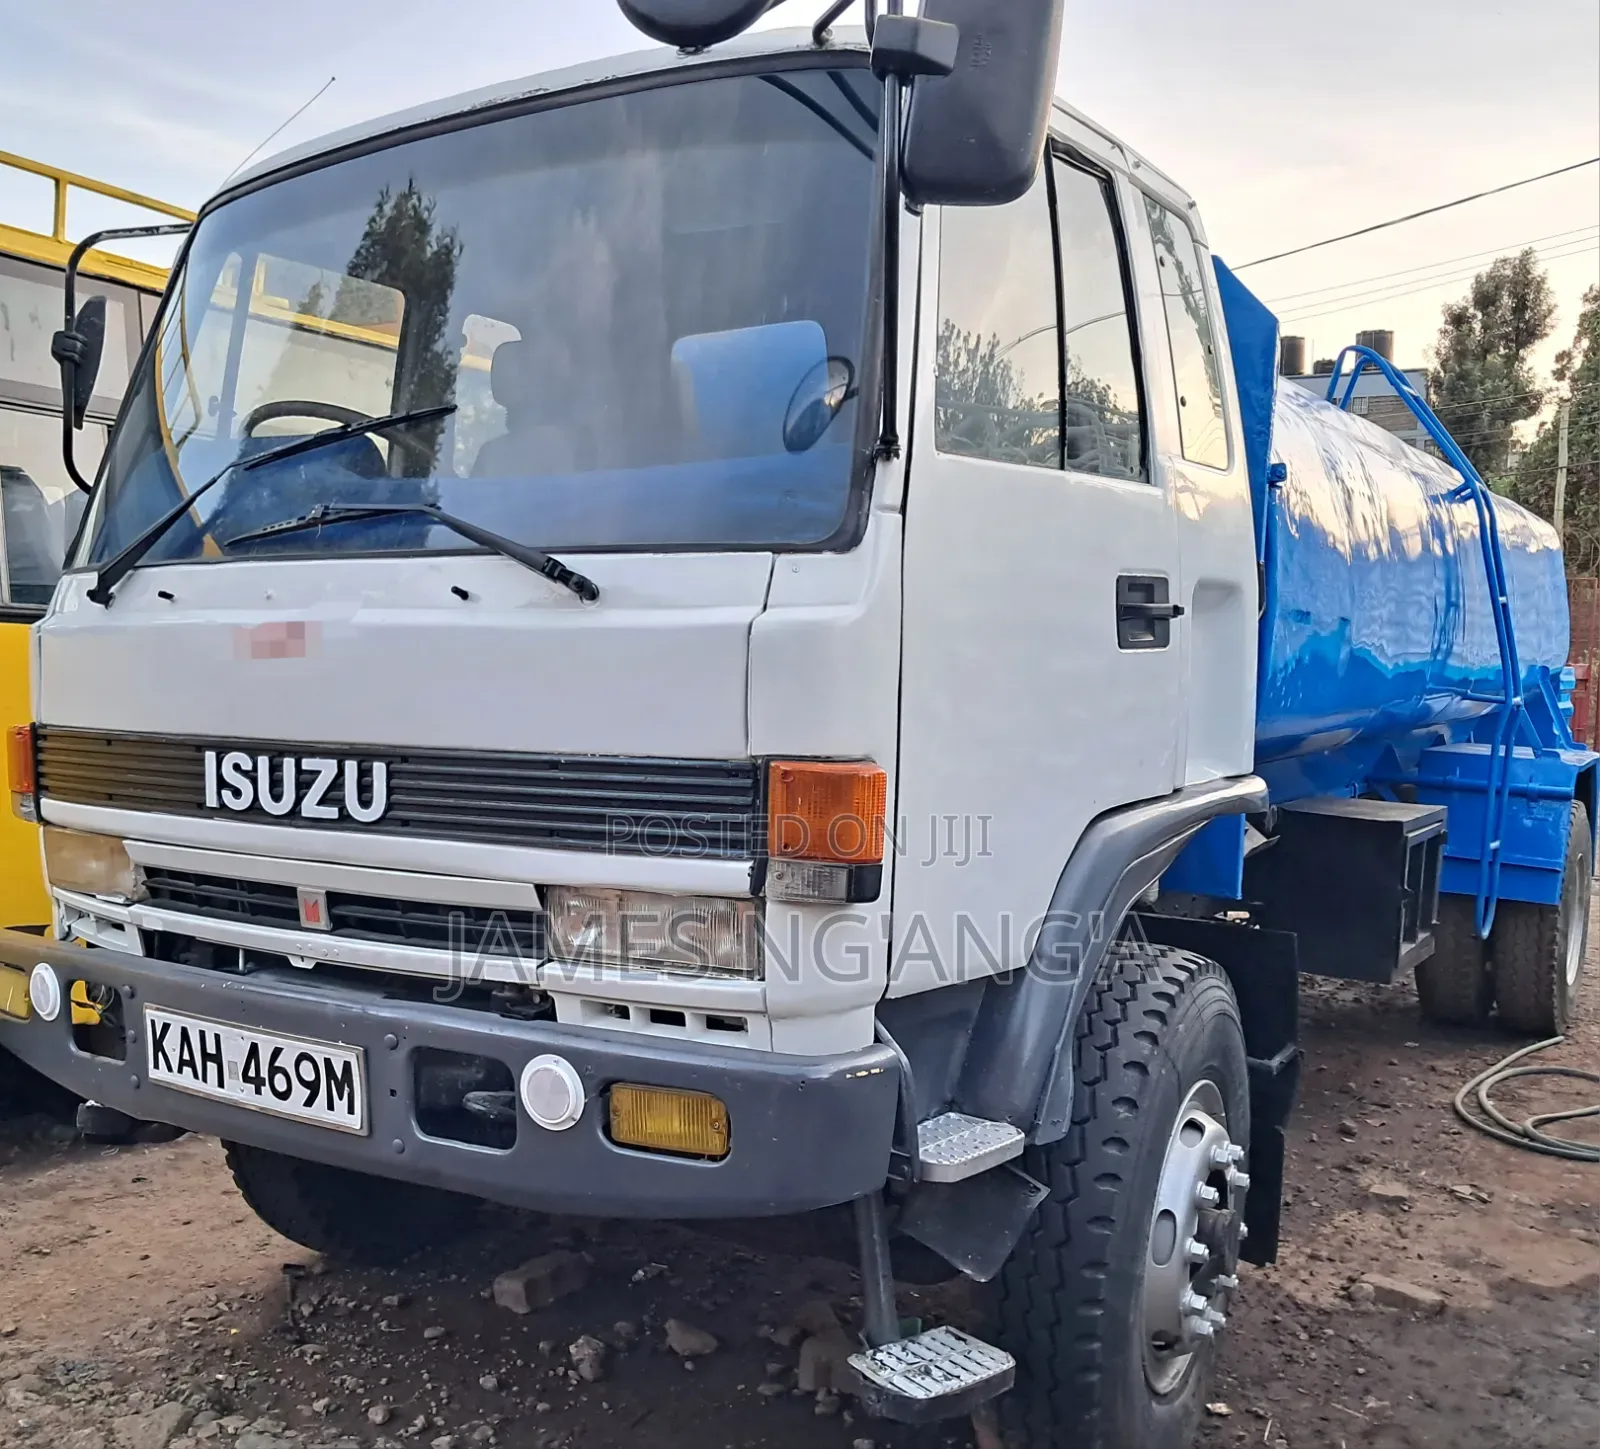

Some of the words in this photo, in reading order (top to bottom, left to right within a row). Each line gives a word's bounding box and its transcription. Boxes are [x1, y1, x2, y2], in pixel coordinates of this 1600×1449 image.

[204, 751, 387, 823] ISUZU
[150, 1018, 225, 1090] KAH
[241, 1041, 355, 1116] 469M
